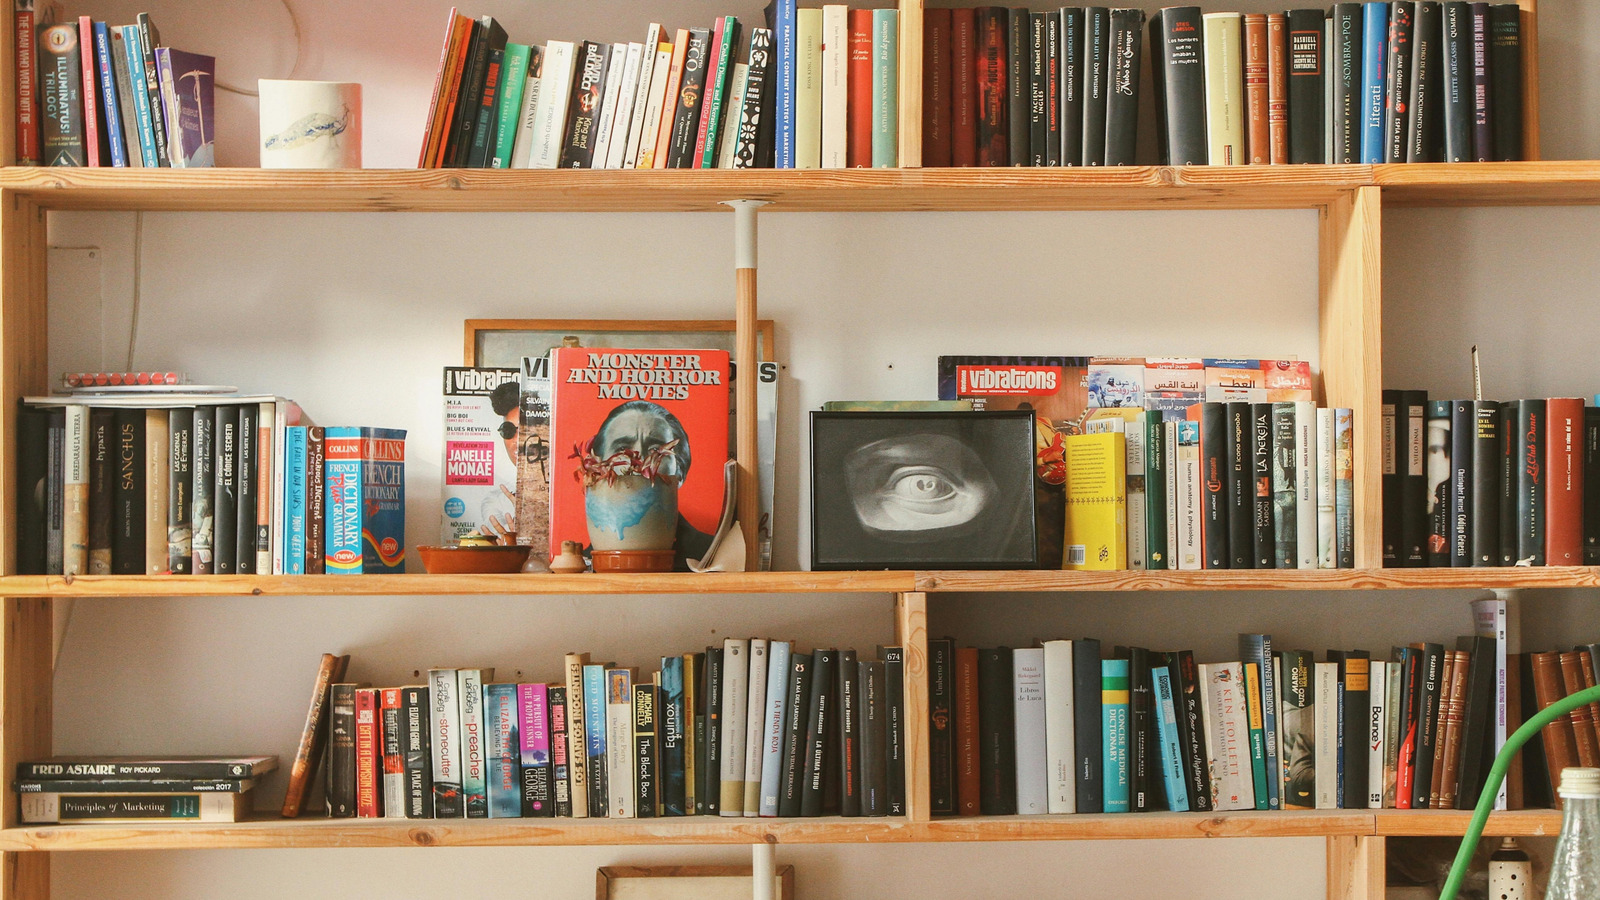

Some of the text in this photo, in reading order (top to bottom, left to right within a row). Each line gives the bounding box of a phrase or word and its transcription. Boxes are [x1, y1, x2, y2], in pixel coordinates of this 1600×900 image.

[18, 16, 29, 29] THE
[1034, 19, 1044, 48] Ondaatje
[1449, 7, 1457, 38] QUMRÁN
[18, 30, 30, 48] MAN
[19, 50, 30, 68] WHO
[581, 44, 597, 90] BALDACCI
[592, 55, 603, 83] DAVID
[686, 38, 702, 72] ECO
[698, 44, 706, 68] umberto
[1420, 61, 1426, 69] DE
[19, 70, 30, 96] WOULD
[45, 71, 56, 119] TRILOGY
[57, 56, 70, 134] ILLUMINATUS!
[1395, 70, 1403, 111] GÓMEZ-JURADO
[20, 98, 30, 112] NOT
[706, 43, 728, 152] Crohn's Disease and Ulcerative Colitis
[1370, 85, 1381, 128] Literati
[20, 114, 31, 124] DIE
[526, 103, 536, 130] DUNANT
[545, 106, 554, 132] GEORGE
[699, 121, 707, 139] SIETE
[703, 88, 712, 118] PODERES
[572, 116, 584, 146] Maxwell
[579, 117, 592, 149] King and
[586, 353, 701, 370] MONSTER
[566, 369, 721, 386] AND HORROR
[970, 368, 1056, 390] vibrations
[1272, 376, 1305, 388] البطل
[597, 384, 690, 400] MOVIES
[73, 436, 80, 445] LA
[328, 445, 359, 454] COLLINS
[363, 440, 402, 459] COLLINS
[224, 424, 233, 486] EL CÓDICE SECRETO
[329, 463, 359, 473] FRENCH
[448, 450, 492, 462] JANELLE
[448, 462, 492, 476] MONAE
[327, 473, 344, 504] Plus
[364, 486, 399, 500] DICTIONARY
[1457, 469, 1465, 494] Christopher
[313, 484, 322, 520] INCIDENT
[343, 473, 359, 548] DICTIONARY
[333, 503, 344, 548] GRAMMAR
[1457, 514, 1466, 533] Código
[335, 552, 354, 560] new
[381, 540, 397, 551] new
[1458, 534, 1466, 556] Génesis
[524, 687, 534, 748] THE PROPER SINNER
[636, 690, 645, 727] CONNELLY
[644, 693, 652, 725] MICHAEL
[1216, 690, 1224, 718] WORLD
[552, 705, 564, 732] MICHAEL
[571, 663, 584, 786] LOS SANTOS INOCENTES
[666, 703, 676, 748] Equinox
[1118, 709, 1126, 746] CONCISE
[1223, 688, 1239, 777] KEN FOLLETT
[1371, 706, 1381, 742] Bounce
[440, 718, 450, 778] stonecutter
[500, 696, 512, 791] ELIZABETH GEORGE
[1109, 709, 1118, 762] DICTIONARY
[1219, 721, 1227, 757] WITHOUT
[465, 723, 482, 780] preacher
[32, 764, 161, 775] FRED ASTAIRE ROY PICKARD
[640, 739, 650, 798] The Black Box
[525, 768, 539, 801] GEORGE
[537, 768, 547, 800] ELIZABETH
[556, 780, 568, 802] CONGO
[65, 802, 165, 813] Principles of Marketing
